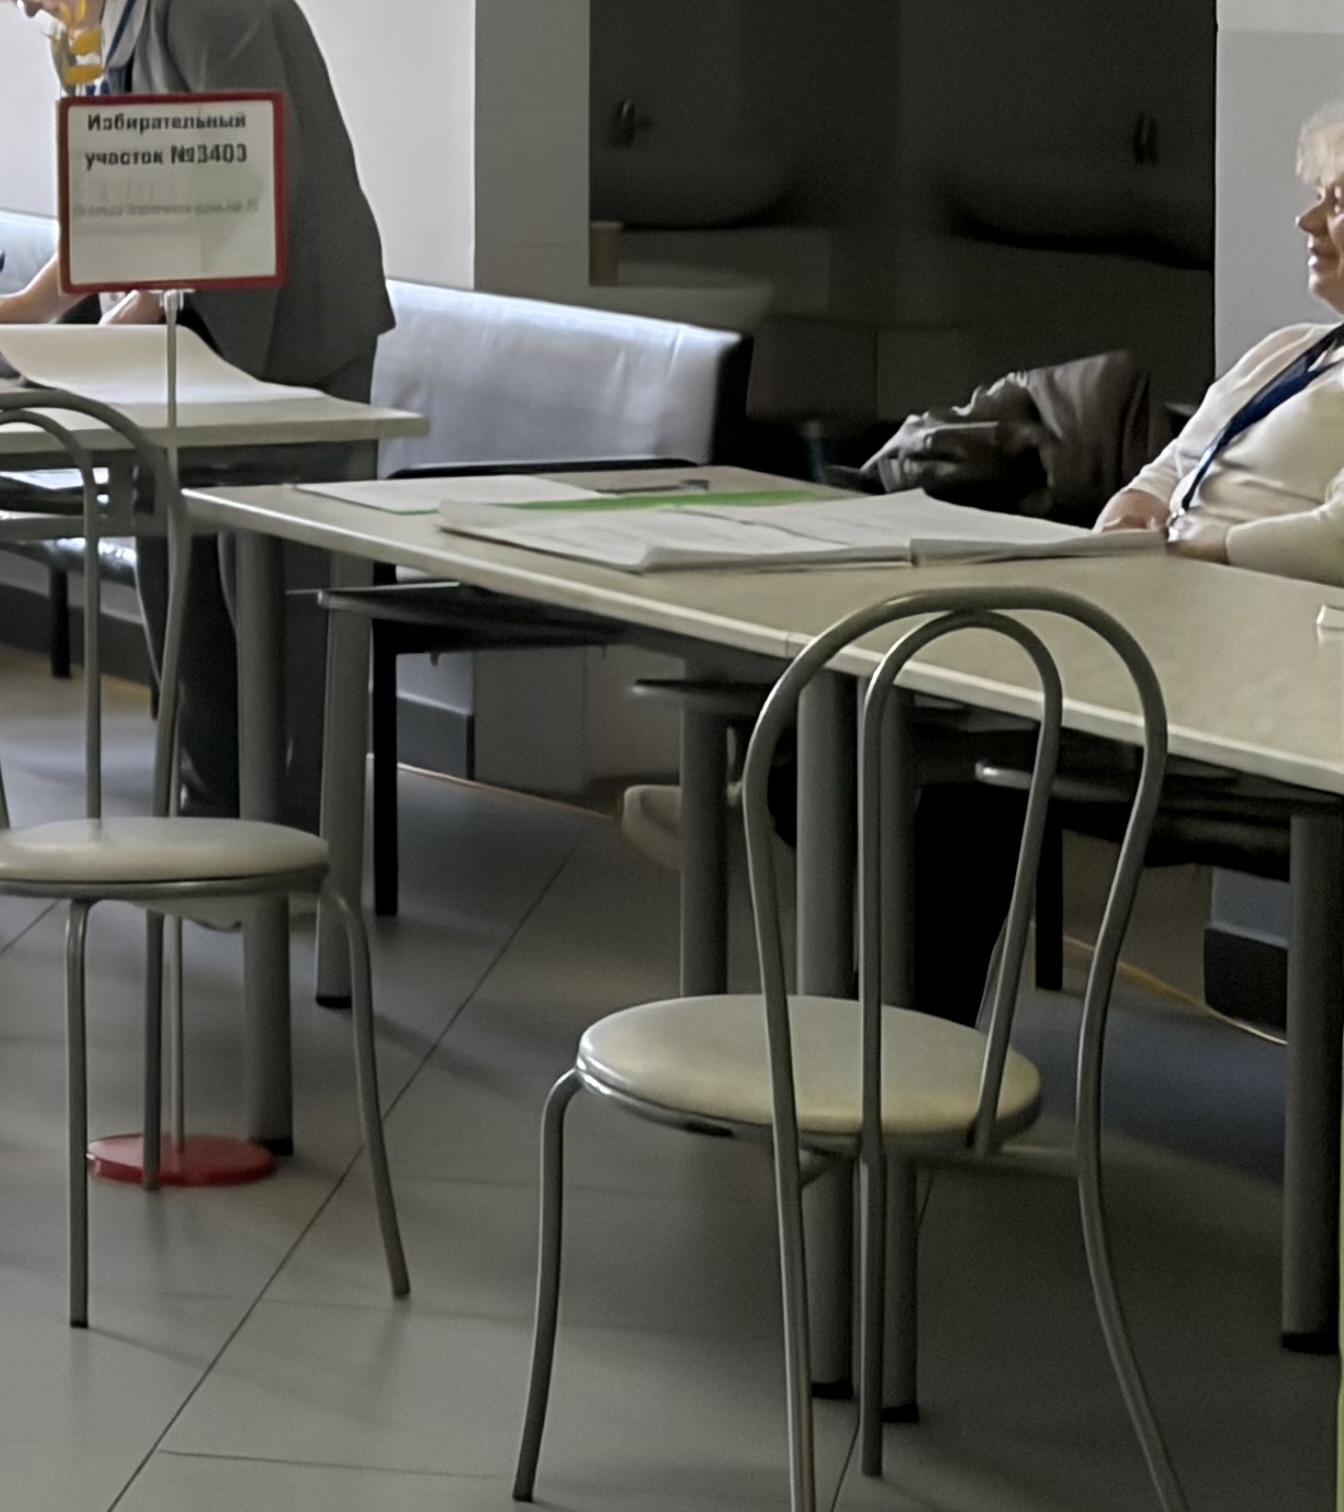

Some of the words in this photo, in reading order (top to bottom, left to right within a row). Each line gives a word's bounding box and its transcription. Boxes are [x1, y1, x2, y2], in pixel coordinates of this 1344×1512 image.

[87, 111, 247, 135] Избирательный
[85, 150, 164, 171] участок
[170, 143, 248, 165] №3403
